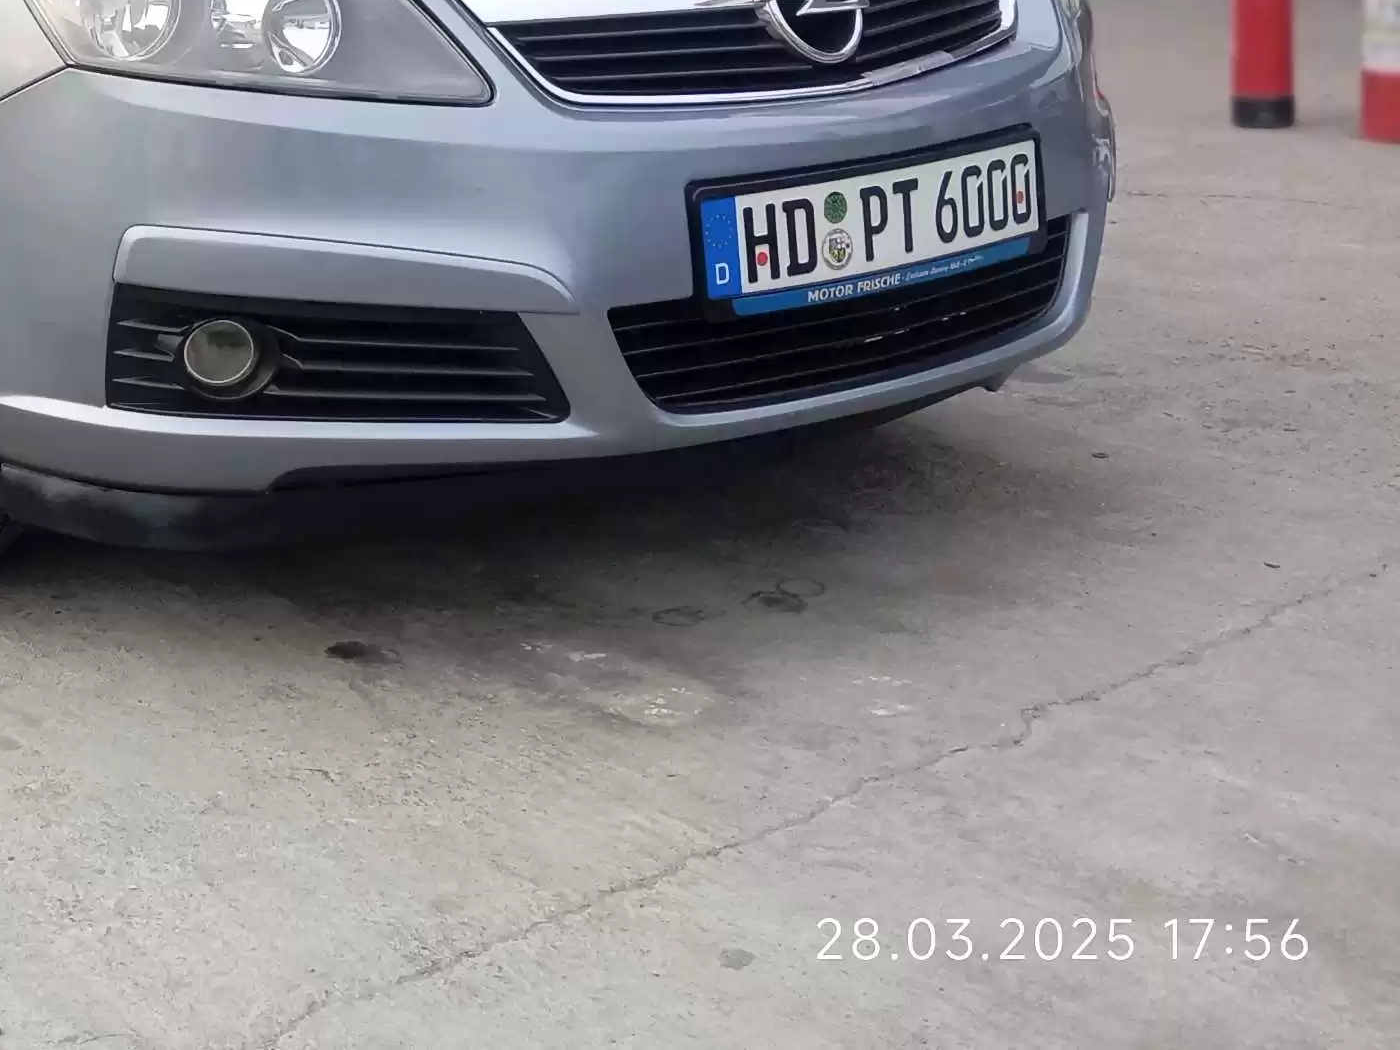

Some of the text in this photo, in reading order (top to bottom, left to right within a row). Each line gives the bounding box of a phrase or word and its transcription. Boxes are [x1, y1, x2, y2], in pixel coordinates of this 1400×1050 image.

[742, 153, 1033, 284] HD PT 6000
[715, 262, 729, 286] D
[807, 272, 902, 303] MOTOR FRISCHE
